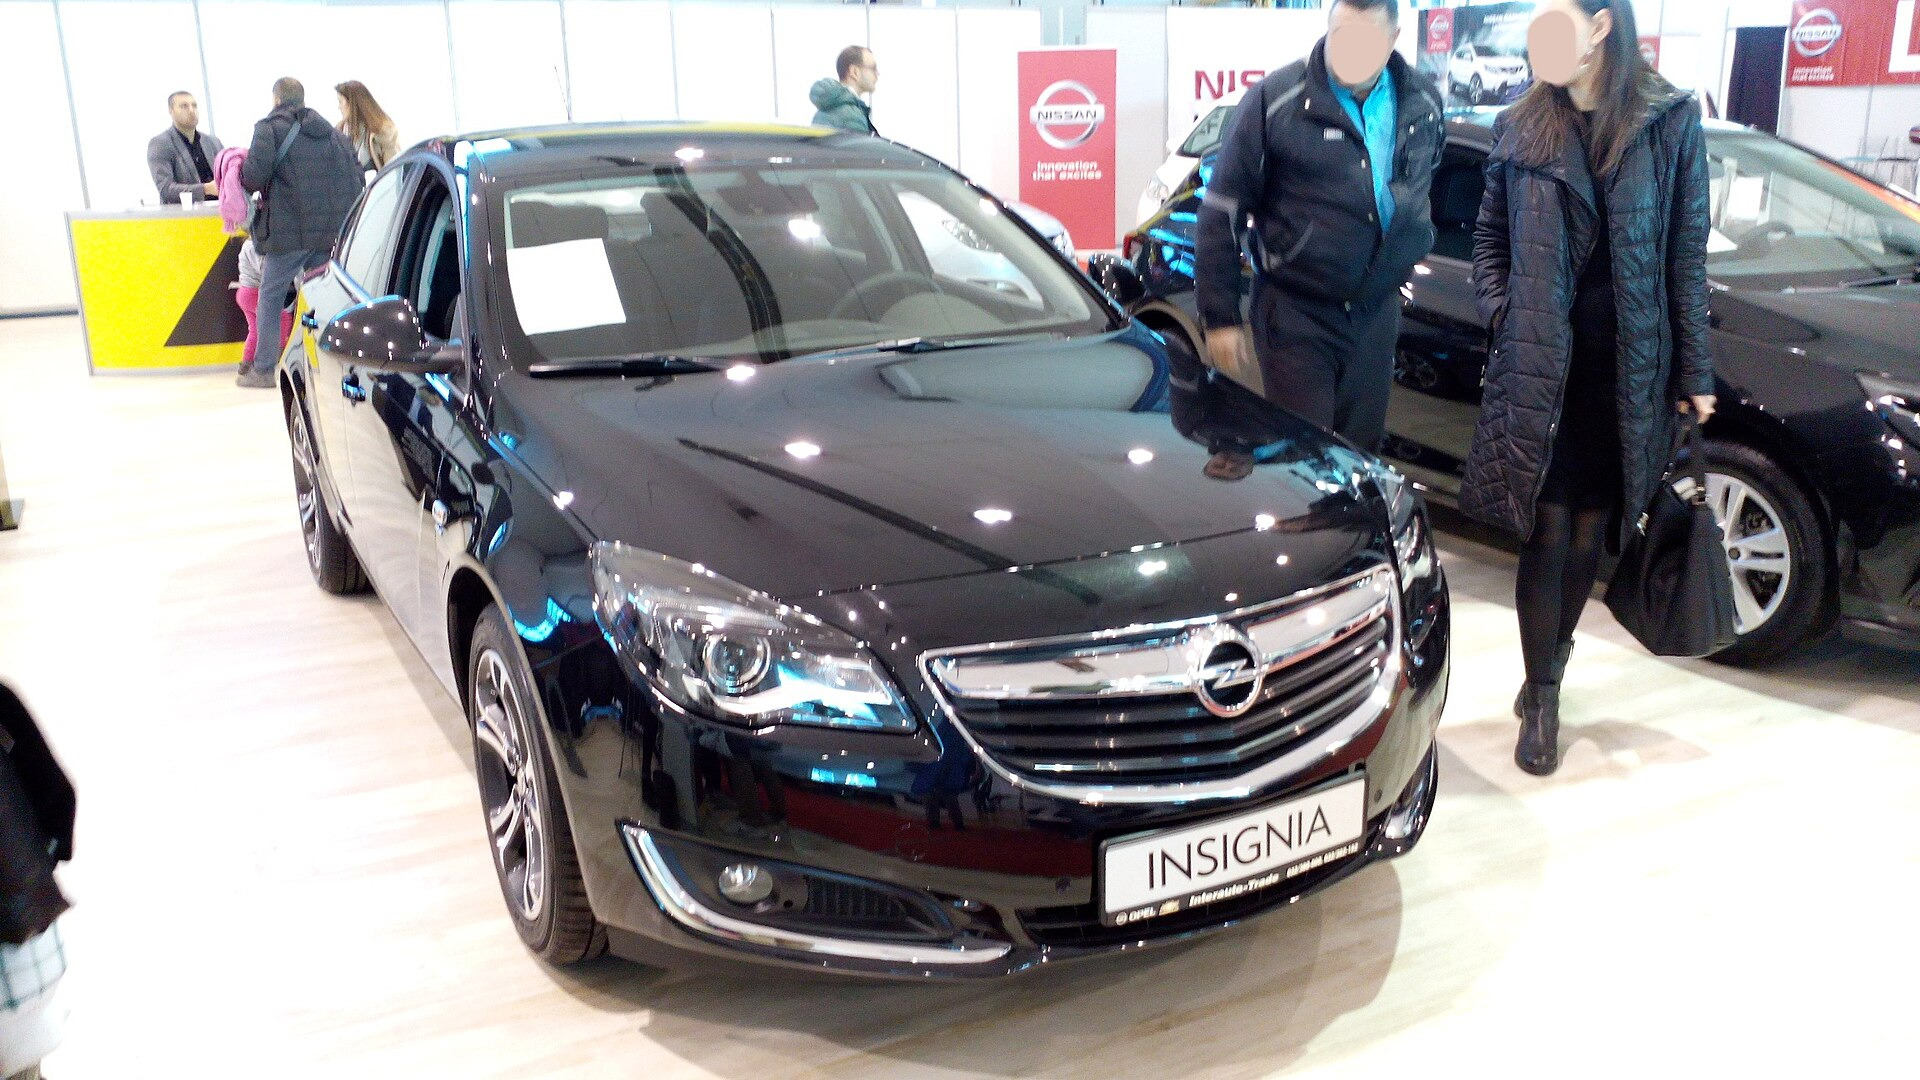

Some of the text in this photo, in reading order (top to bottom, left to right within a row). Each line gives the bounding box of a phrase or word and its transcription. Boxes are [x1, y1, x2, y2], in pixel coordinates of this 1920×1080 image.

[1795, 30, 1837, 38] NISSAN
[1195, 70, 1265, 100] NIS
[1037, 109, 1097, 121] NISSAN
[1032, 170, 1103, 181] that excites
[1149, 804, 1332, 890] INSIGNIA
[1128, 906, 1157, 922] OPEL
